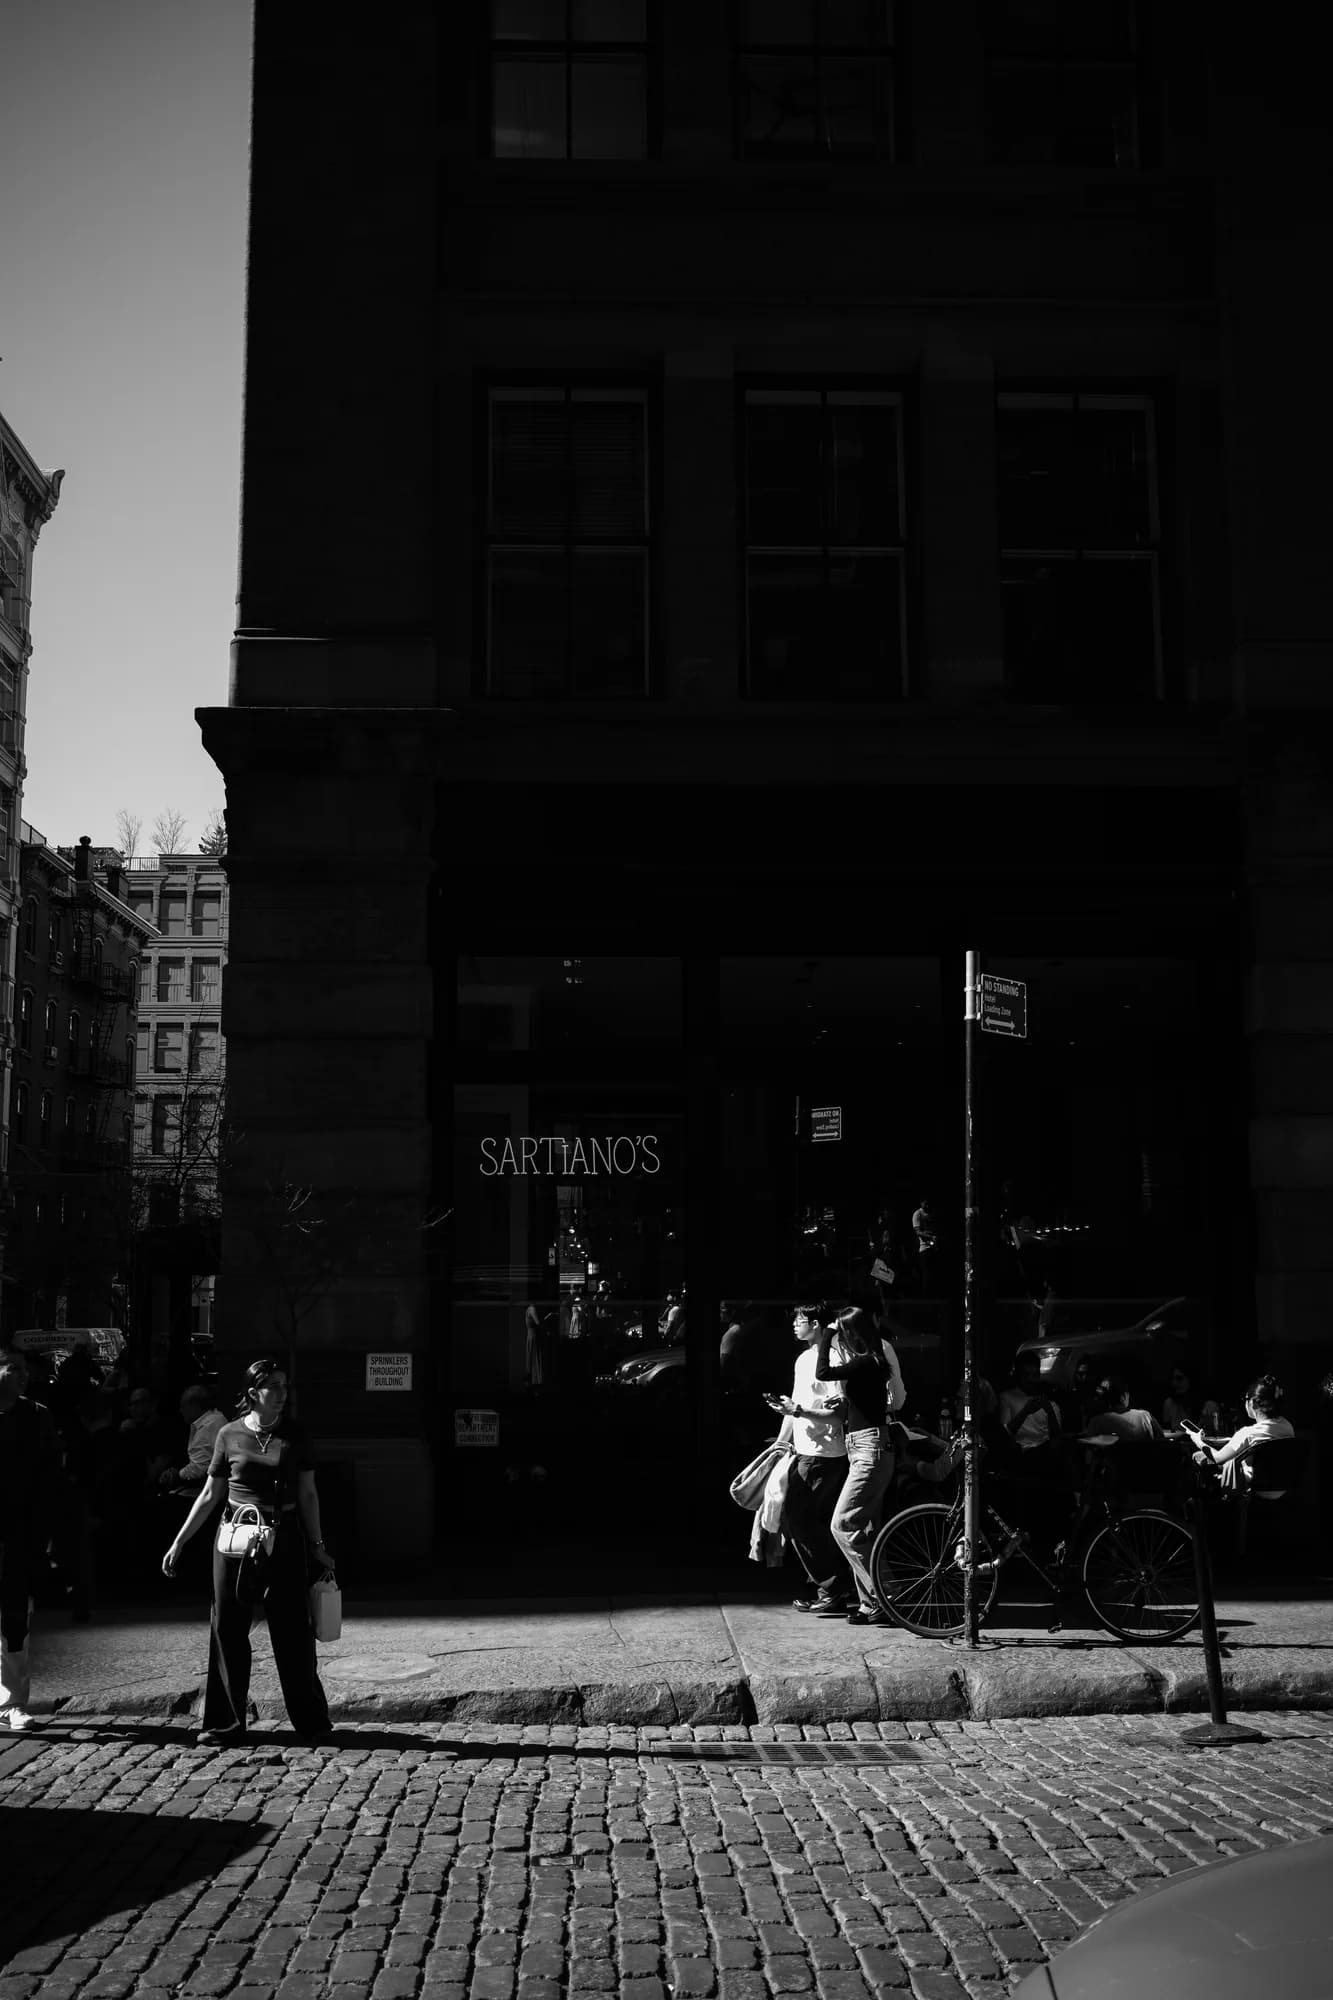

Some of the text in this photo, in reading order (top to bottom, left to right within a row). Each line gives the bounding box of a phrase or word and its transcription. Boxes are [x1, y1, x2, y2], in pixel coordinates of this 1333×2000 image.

[984, 980, 1019, 997] NO STANDING
[371, 1356, 408, 1365] SPRINKLERS
[369, 1367, 409, 1376] THROUGHOUT
[375, 1377, 403, 1386] BUILDING
